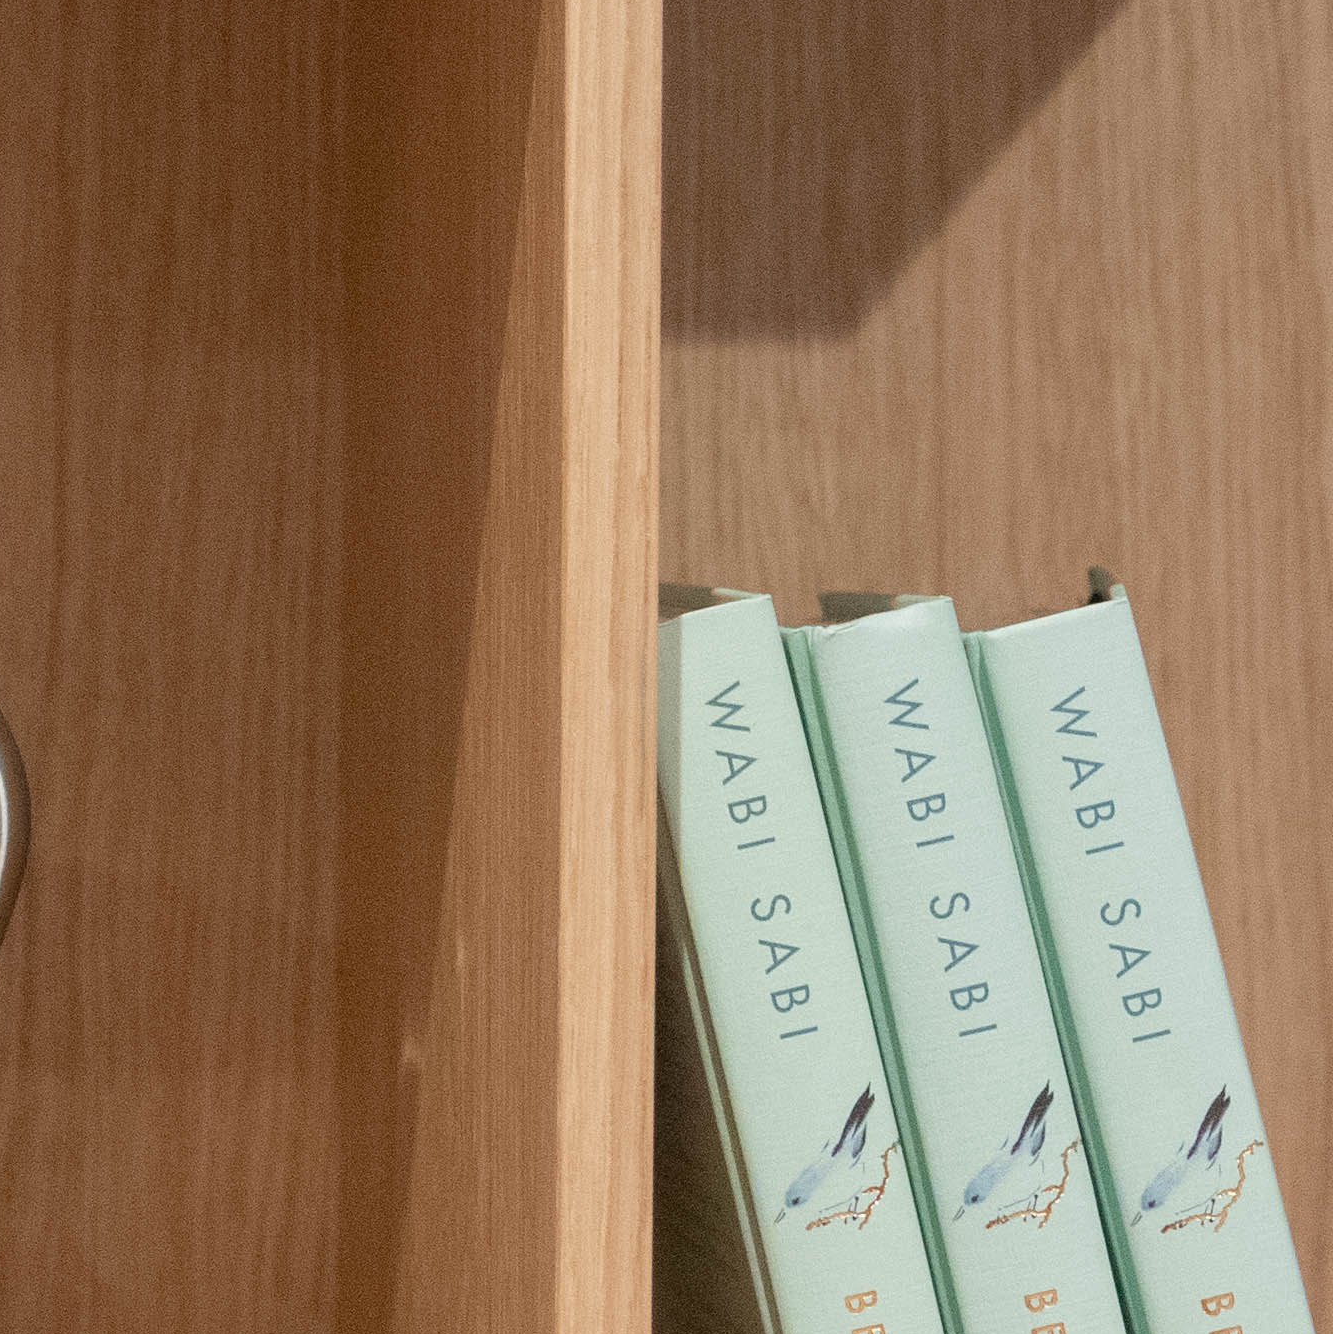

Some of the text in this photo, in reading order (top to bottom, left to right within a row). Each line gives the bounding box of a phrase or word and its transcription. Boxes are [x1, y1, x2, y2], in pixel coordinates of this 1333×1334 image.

[705, 679, 819, 1040] WABI SABI
[883, 677, 998, 1038] WABI SABI
[1050, 685, 1172, 1044] WABI SABI
